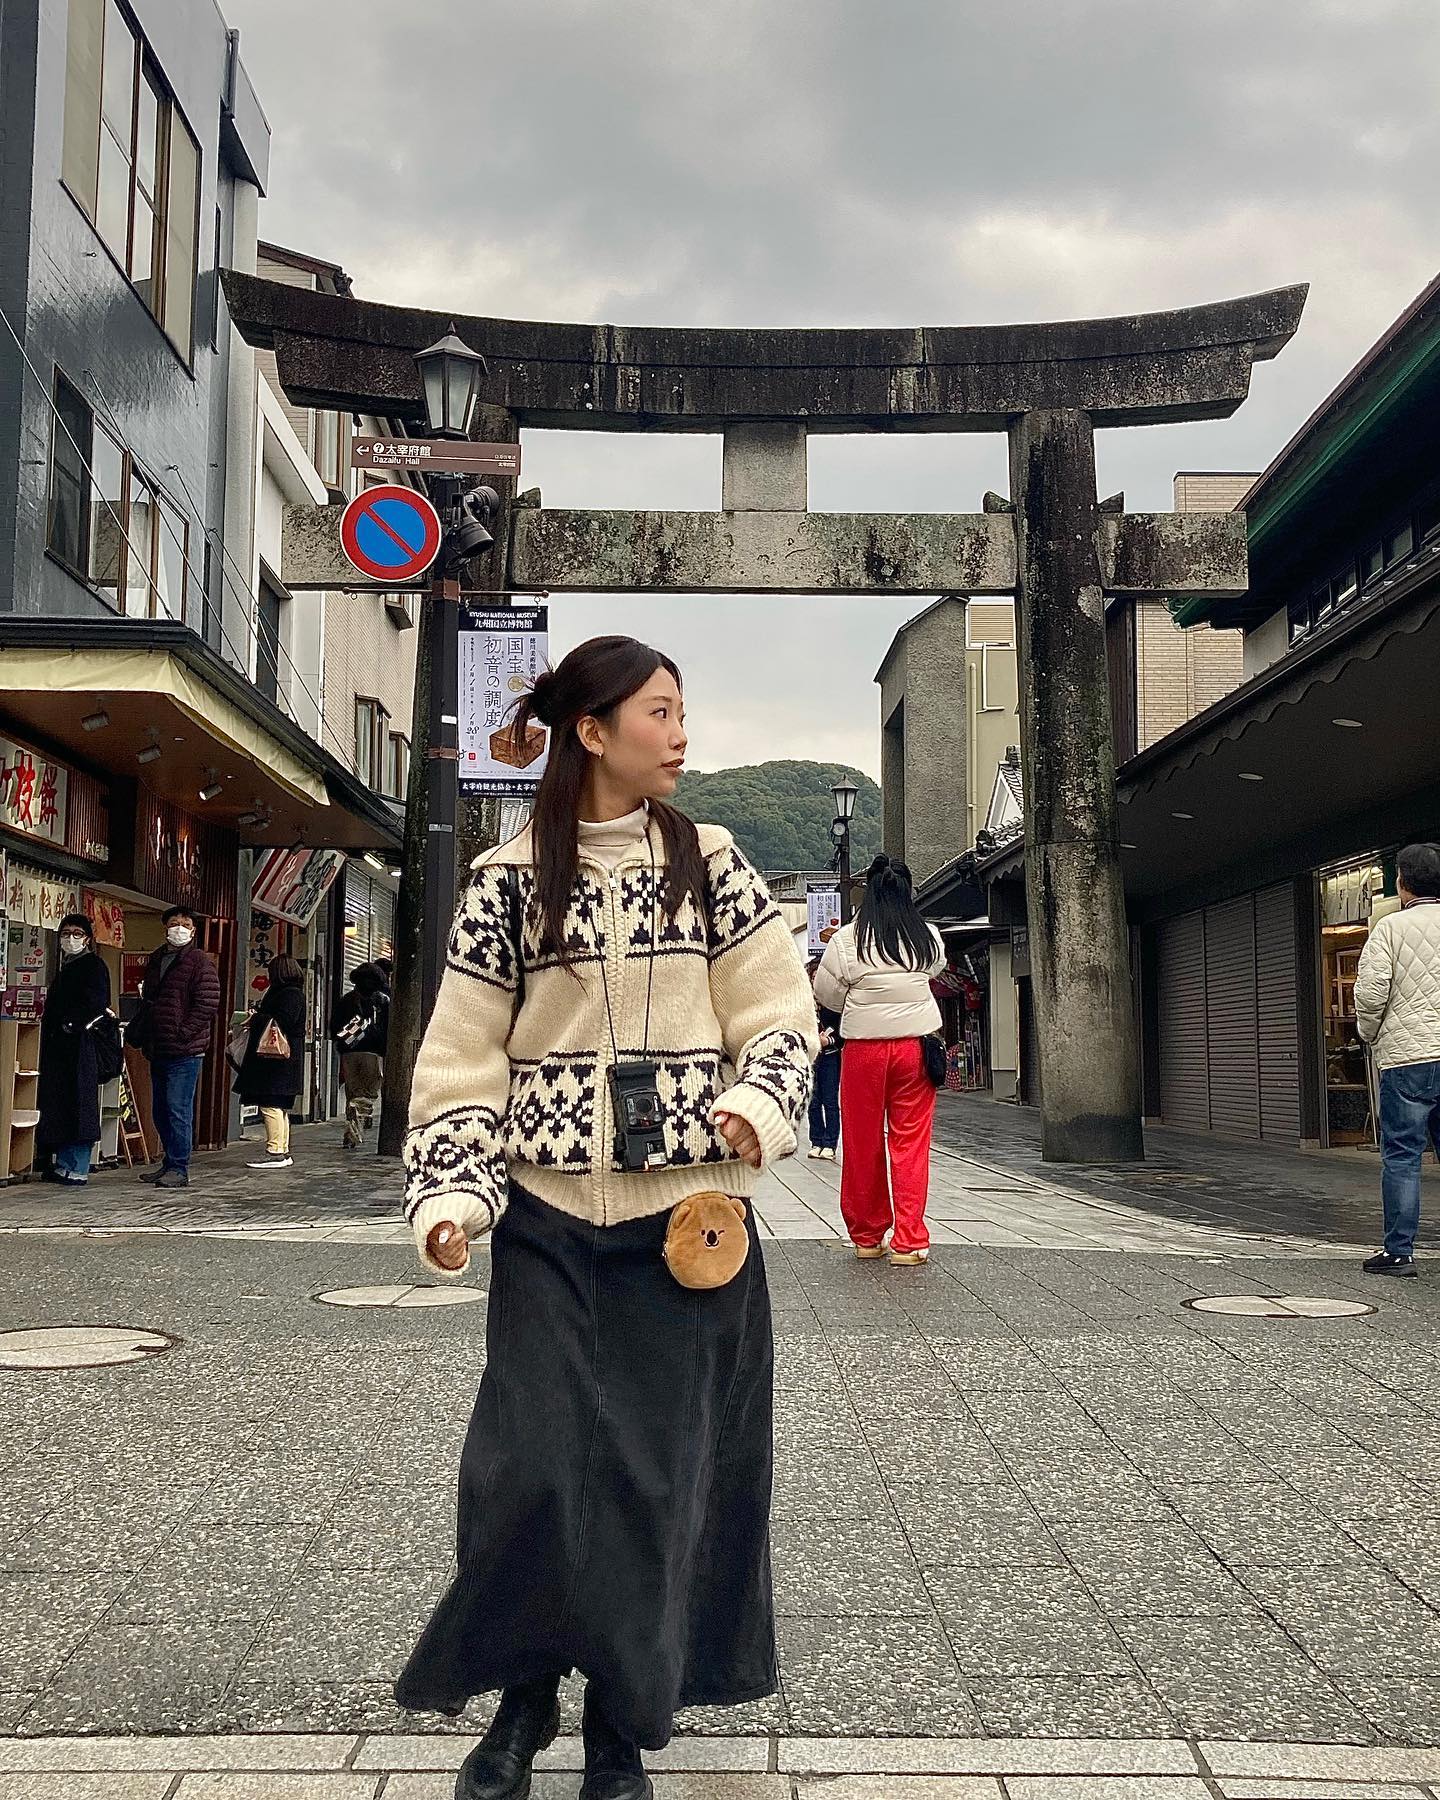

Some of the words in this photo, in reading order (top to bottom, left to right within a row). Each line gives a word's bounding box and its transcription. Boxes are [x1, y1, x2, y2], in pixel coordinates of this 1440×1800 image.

[386, 444, 432, 457] 太宰府館
[373, 456, 401, 464] Dazaifu
[475, 619, 533, 629] 九州国立博物館
[507, 637, 524, 674] 国宝
[483, 636, 503, 728] 初音の調度
